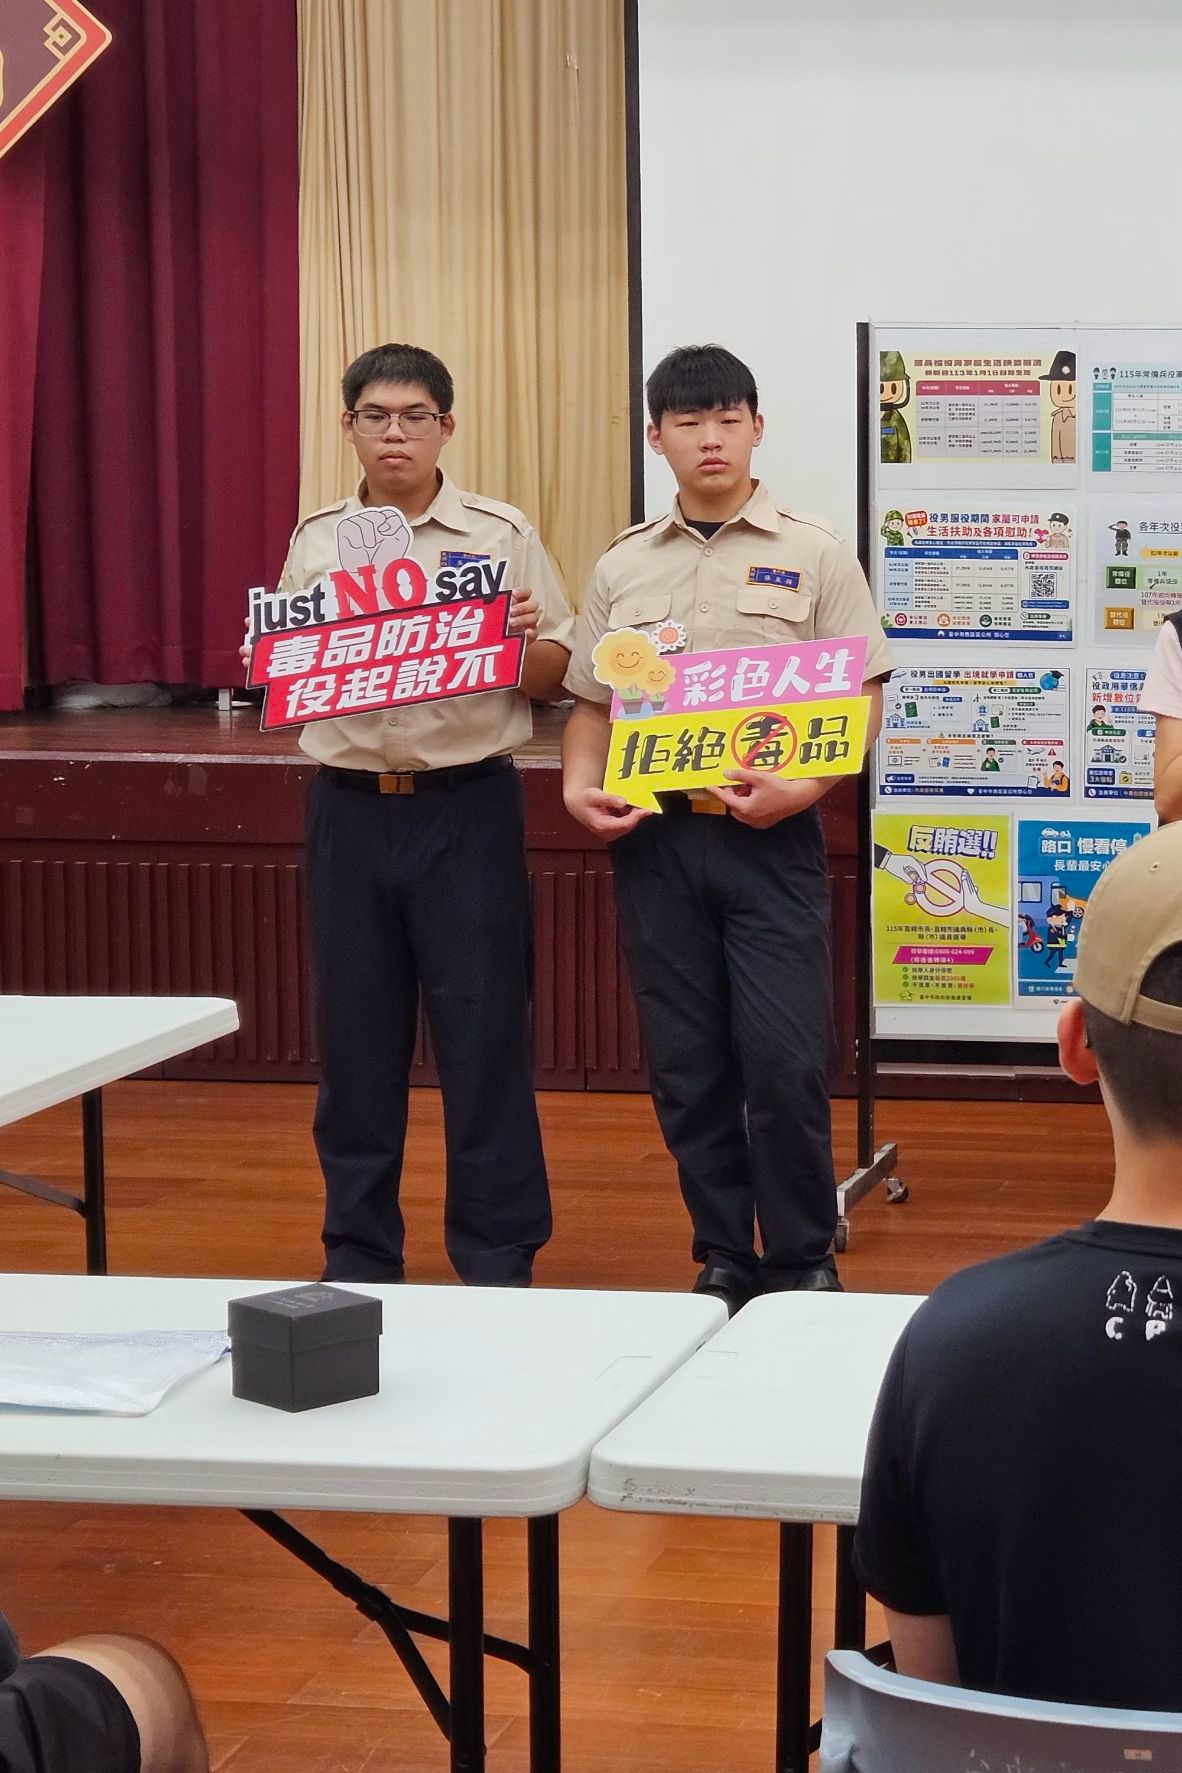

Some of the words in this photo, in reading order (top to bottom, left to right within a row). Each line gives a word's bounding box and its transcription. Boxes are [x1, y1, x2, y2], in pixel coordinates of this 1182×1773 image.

[929, 513, 990, 523] 役男服役期間
[992, 514, 1040, 524] 家屬可申請
[251, 583, 326, 638] just
[329, 558, 429, 618] NO
[434, 560, 507, 604] say
[267, 606, 485, 678] 毒品防治
[286, 645, 504, 718] 役起說不
[682, 649, 856, 707] 彩色人生
[618, 715, 850, 780] 拒絕毒品
[909, 826, 998, 859] 反賄選!!
[1041, 839, 1072, 854] 路口
[1077, 837, 1128, 855] 慢看停
